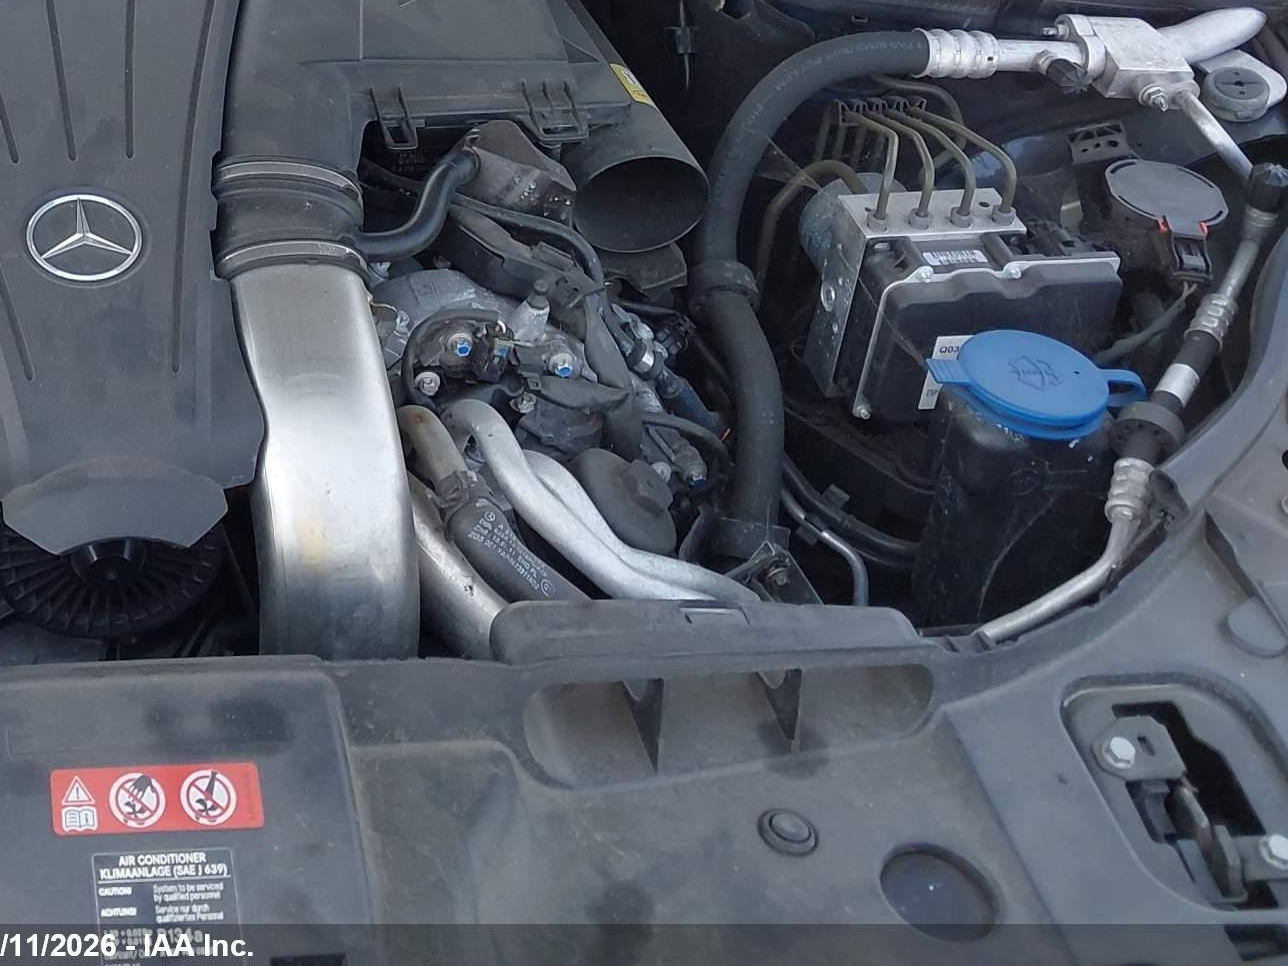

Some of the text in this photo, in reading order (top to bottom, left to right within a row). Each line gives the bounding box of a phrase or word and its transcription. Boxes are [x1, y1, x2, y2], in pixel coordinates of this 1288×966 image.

[118, 852, 207, 867] AIR CONDITIONER
[99, 865, 172, 880] KLIMAANLAGE
[173, 864, 197, 879] (SAE
[204, 863, 228, 876] 639)
[186, 883, 195, 892] be
